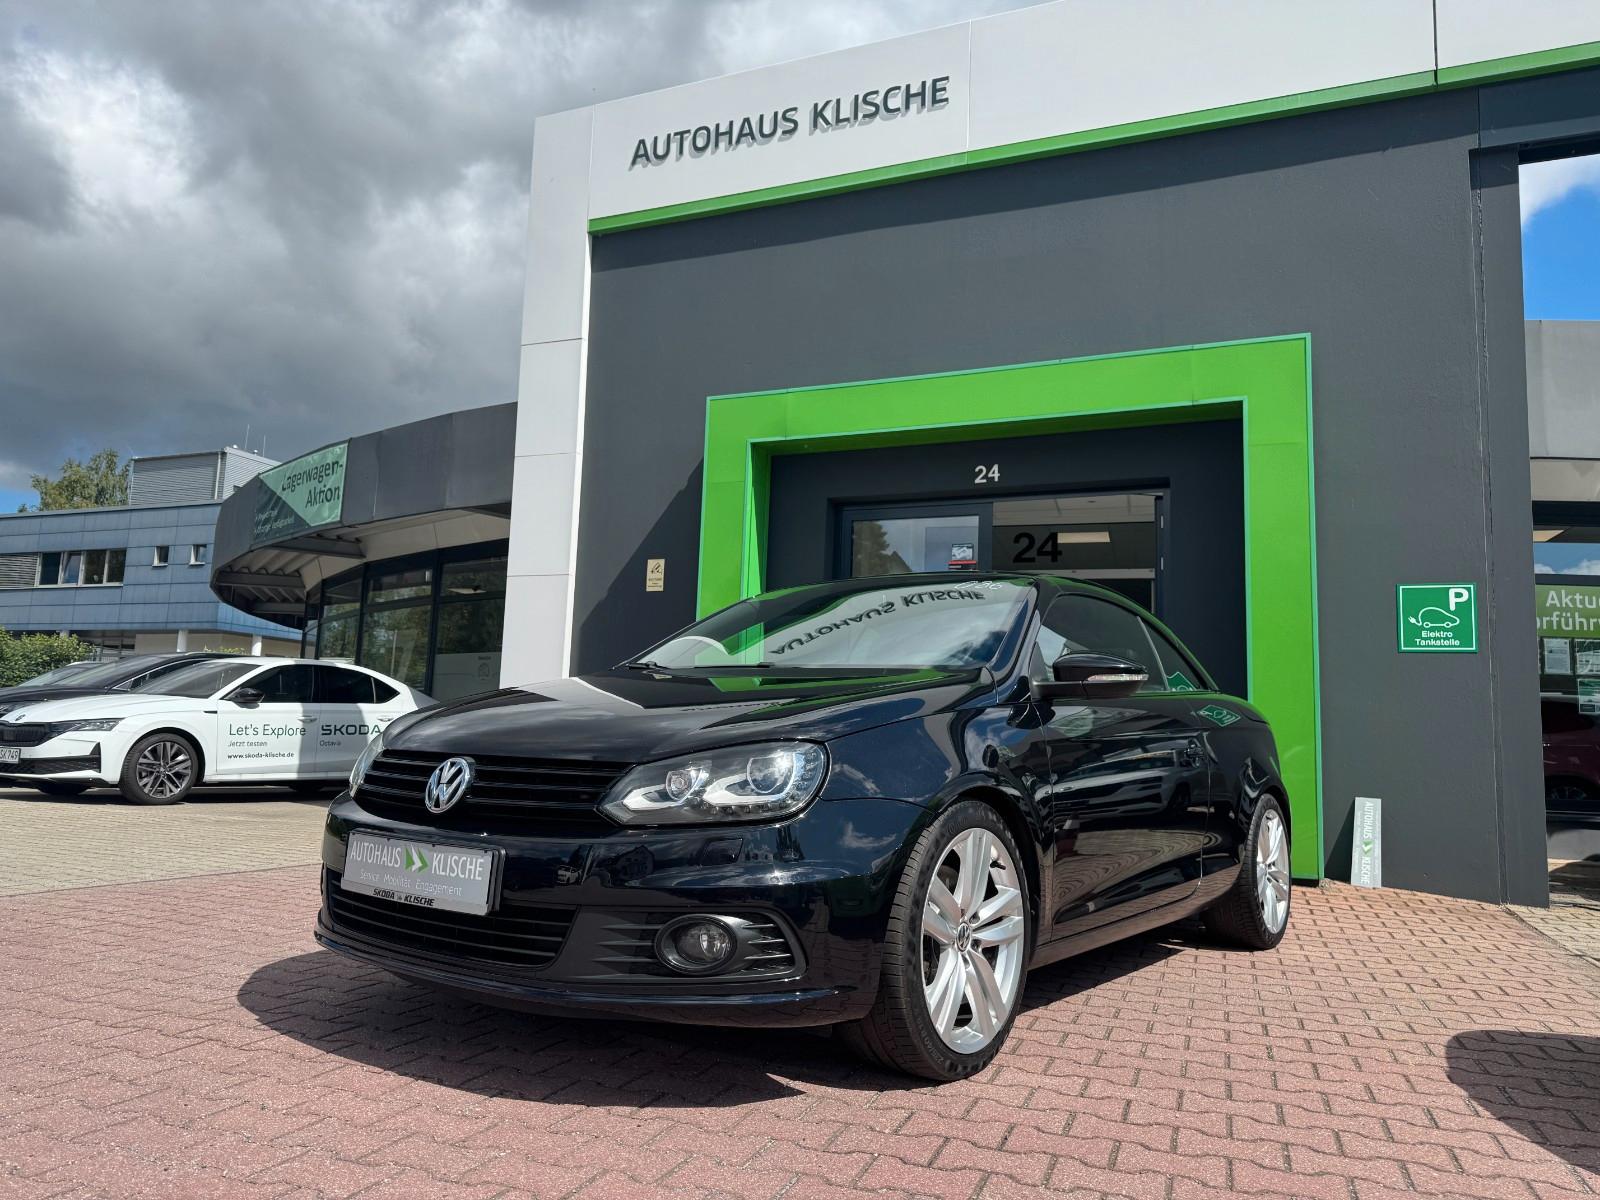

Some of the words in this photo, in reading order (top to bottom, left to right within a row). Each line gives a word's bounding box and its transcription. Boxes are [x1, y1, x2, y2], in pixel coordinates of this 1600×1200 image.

[630, 107, 799, 167] AUTOHAUS
[812, 76, 950, 131] KLISCHE
[281, 460, 343, 492] Lagerwagen-
[974, 463, 1001, 484] 24
[305, 484, 340, 508] Aktion
[1012, 532, 1063, 563] 24
[1448, 588, 1469, 611] P
[1546, 590, 1600, 608] Aktu
[1415, 638, 1460, 646] Tankstelle
[1421, 630, 1453, 638] Elektro
[229, 723, 259, 736] Let's
[262, 724, 306, 739] Explore
[350, 841, 401, 868] AUTOHAUS
[431, 853, 485, 881] KLISCHE
[404, 894, 435, 907] KLISCHE
